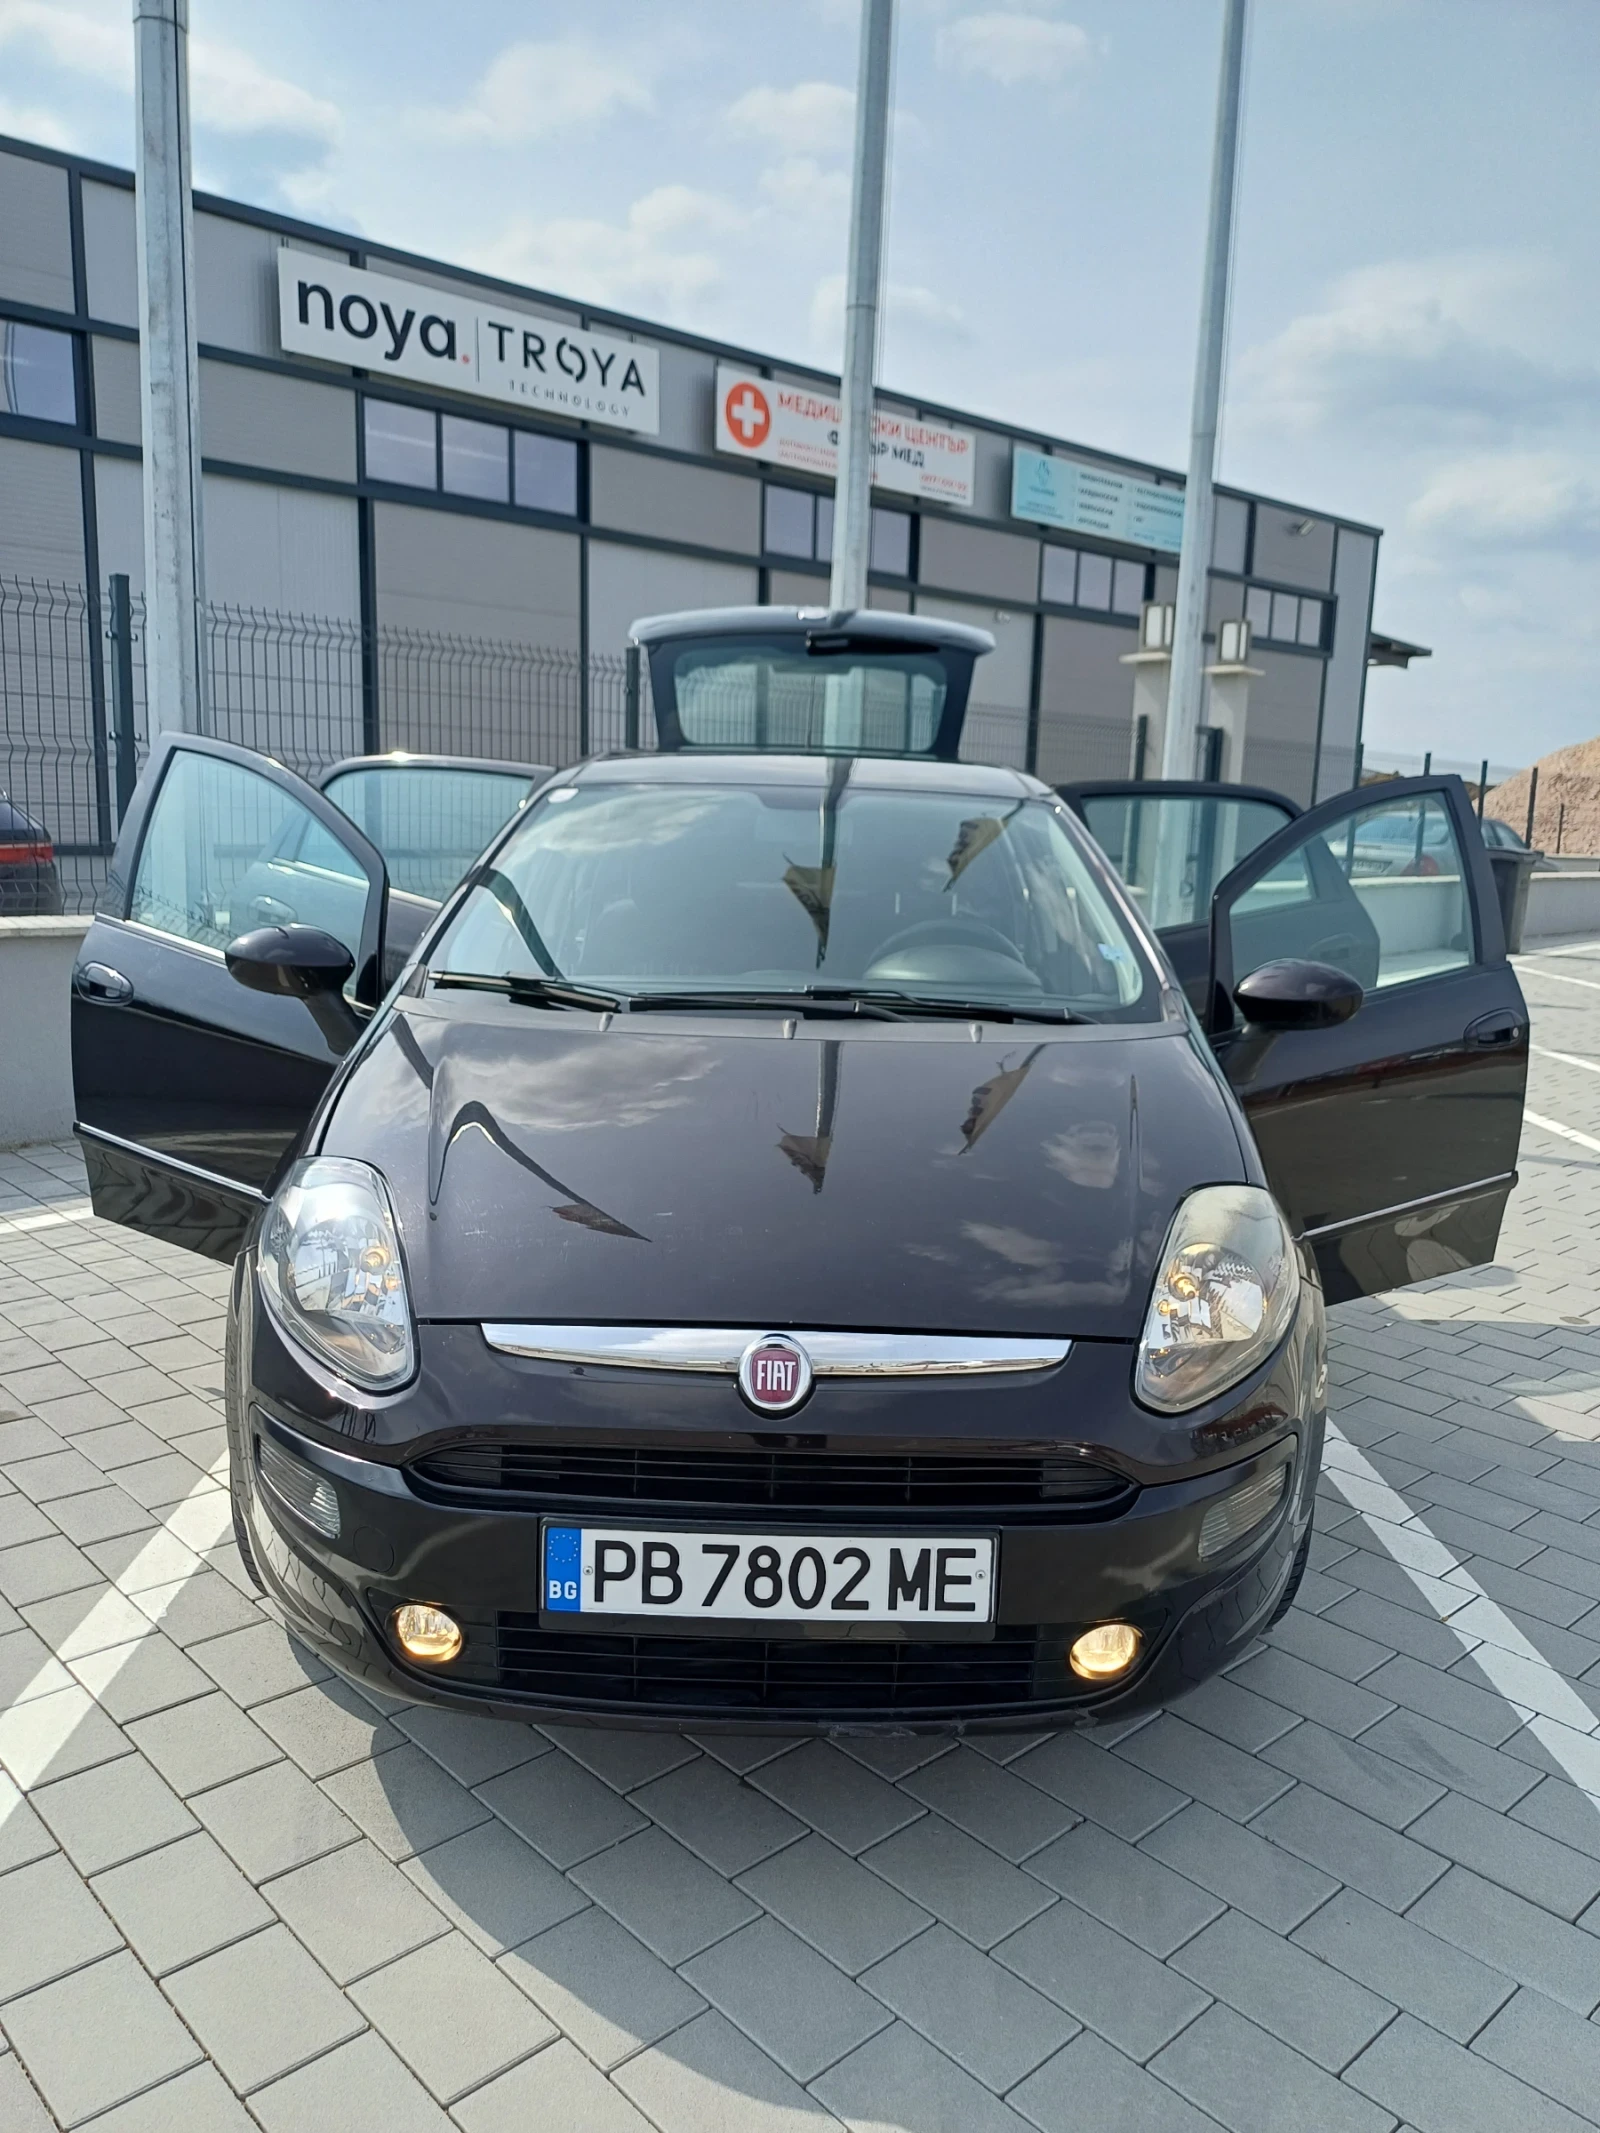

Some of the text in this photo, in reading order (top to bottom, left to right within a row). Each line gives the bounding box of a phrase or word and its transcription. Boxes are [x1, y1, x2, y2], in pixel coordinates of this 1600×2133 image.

[488, 321, 645, 397] TROYA
[509, 379, 631, 418] TECHNOLOGY
[904, 422, 969, 455] ЦЕНТЪР
[756, 1360, 796, 1391] FIAT
[549, 1580, 578, 1600] BG
[594, 1539, 977, 1612] PB 7802 ME
